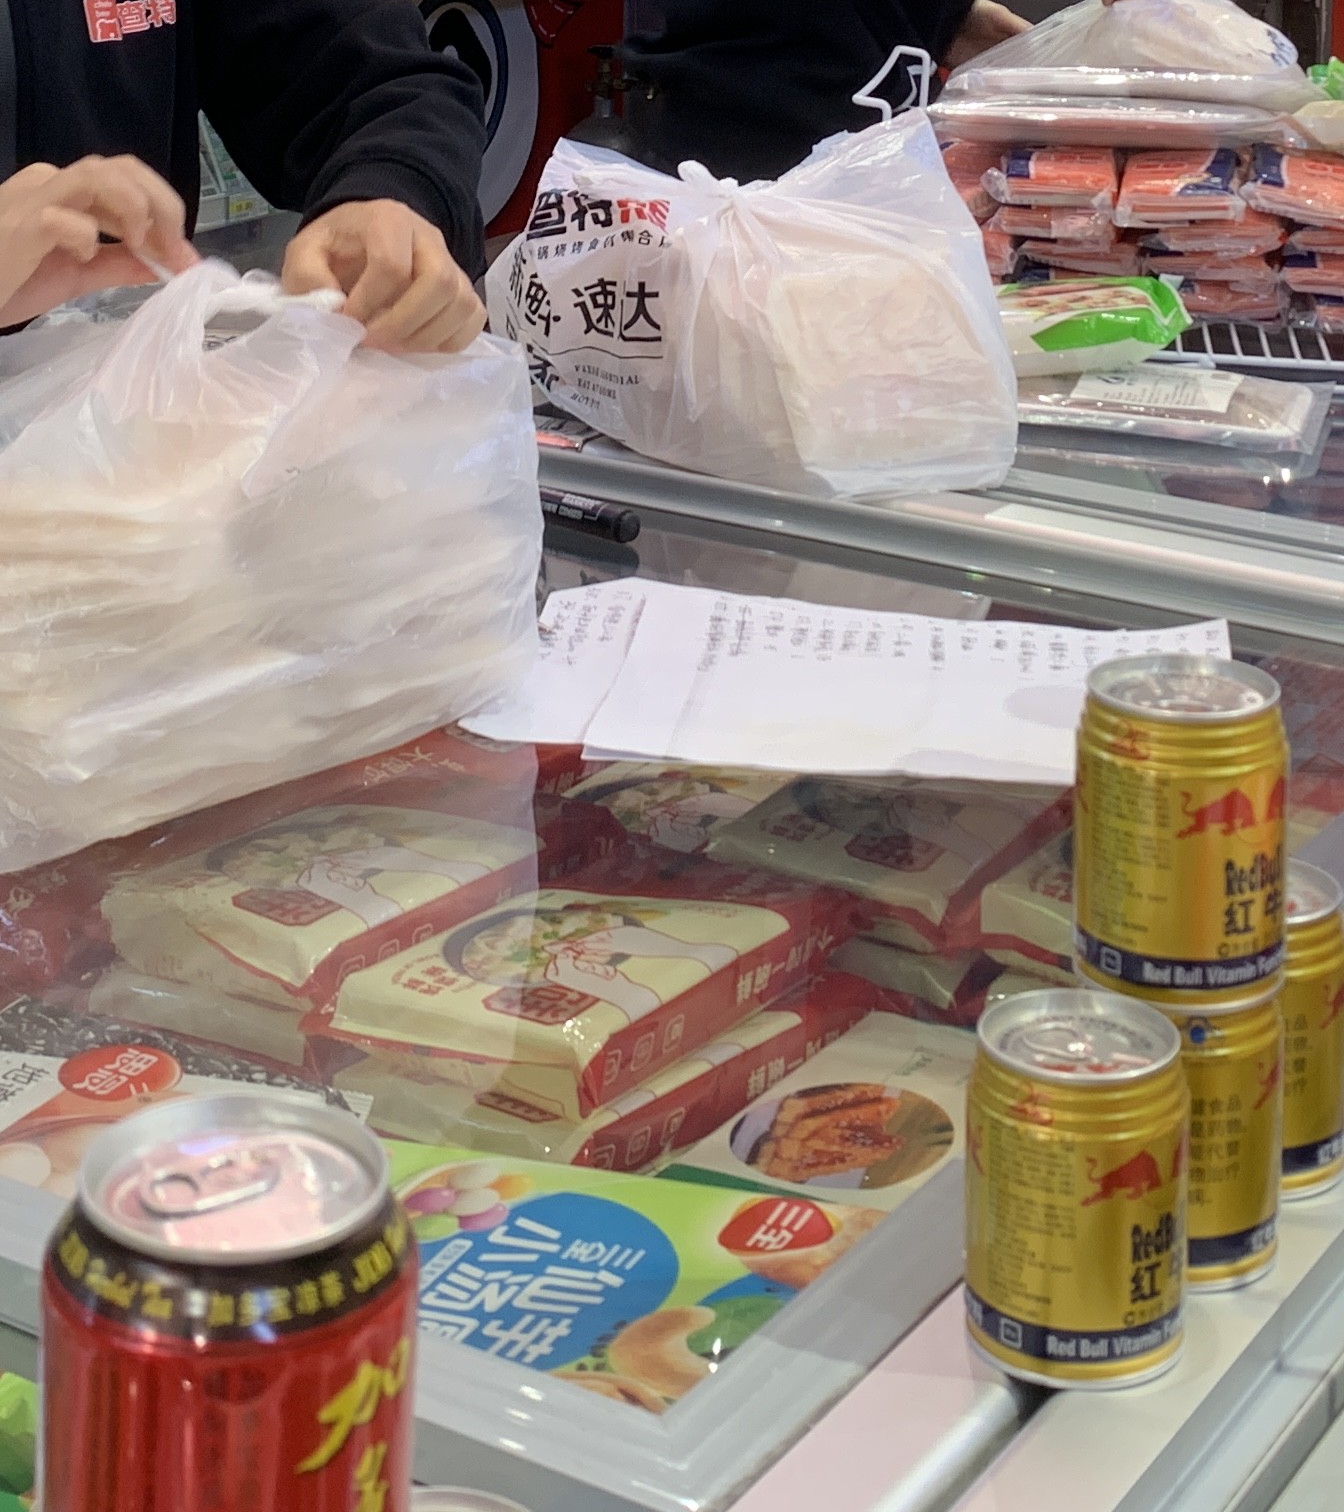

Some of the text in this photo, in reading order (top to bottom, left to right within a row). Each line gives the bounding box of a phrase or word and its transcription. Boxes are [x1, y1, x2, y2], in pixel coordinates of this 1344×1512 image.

[1142, 961, 1171, 985] Red
[1173, 965, 1204, 987] Bull
[1046, 1335, 1077, 1358] Red
[1079, 1331, 1109, 1358] Bull
